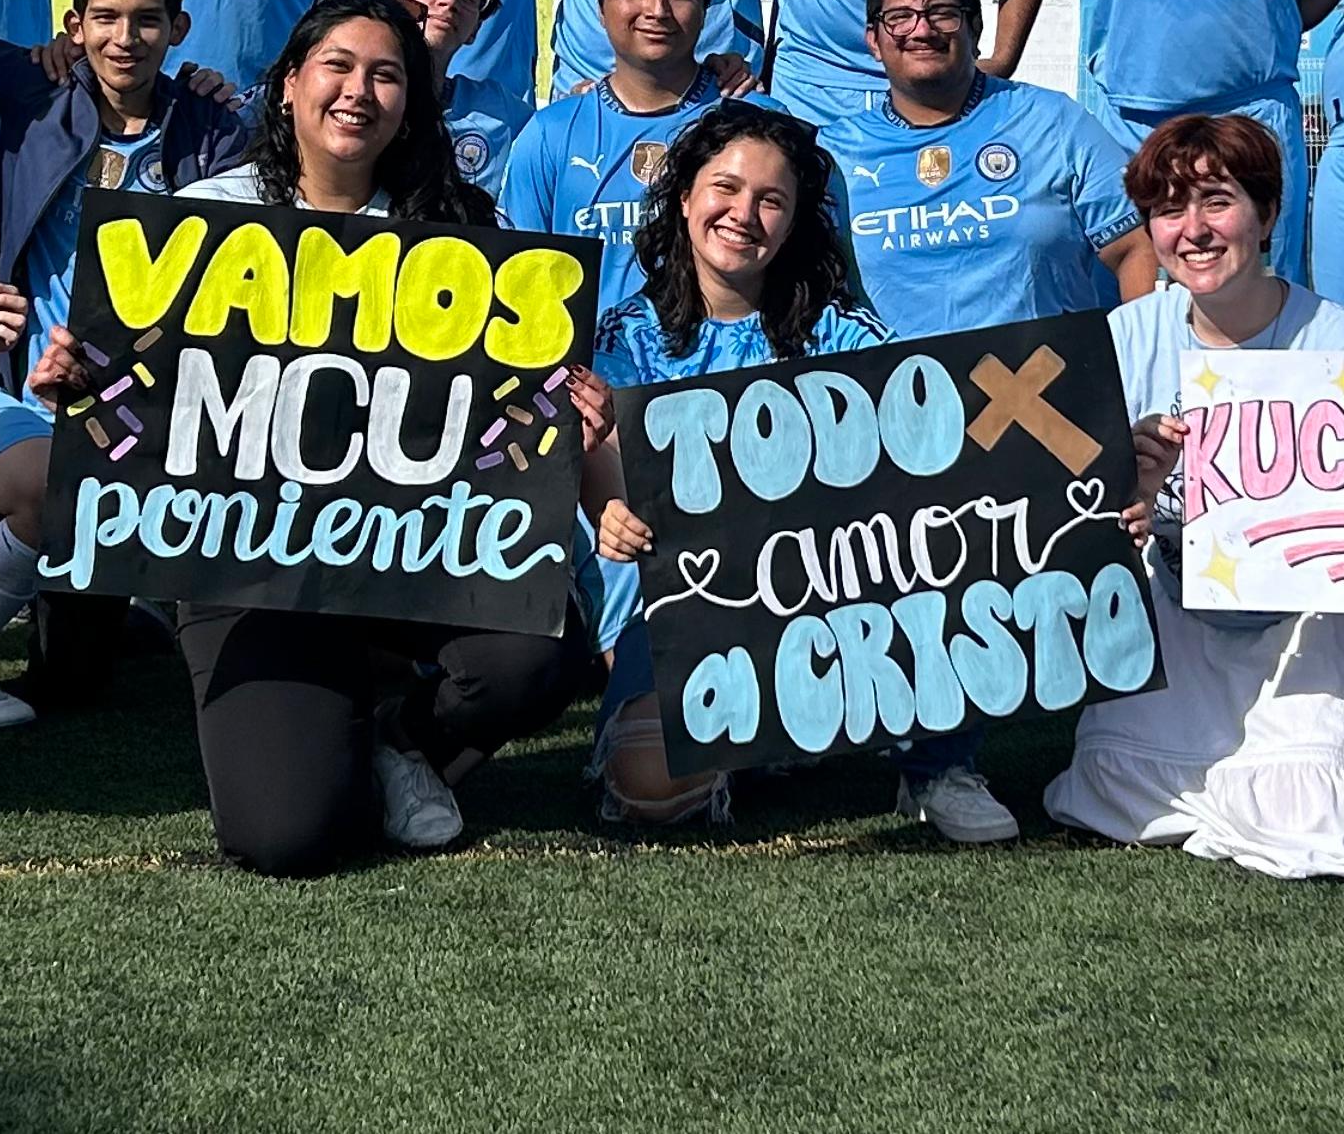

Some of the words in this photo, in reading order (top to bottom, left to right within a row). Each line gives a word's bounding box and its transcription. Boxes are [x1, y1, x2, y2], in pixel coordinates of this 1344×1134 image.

[850, 194, 1020, 236] ETIHAD
[881, 224, 990, 251] AIRWAYS
[96, 215, 585, 370] VAMOS
[164, 347, 473, 486] MCU
[644, 354, 965, 514] TODO
[36, 476, 567, 591] poniente
[755, 495, 1042, 617] amor
[682, 646, 761, 744] a
[774, 562, 1156, 753] CRISTO
